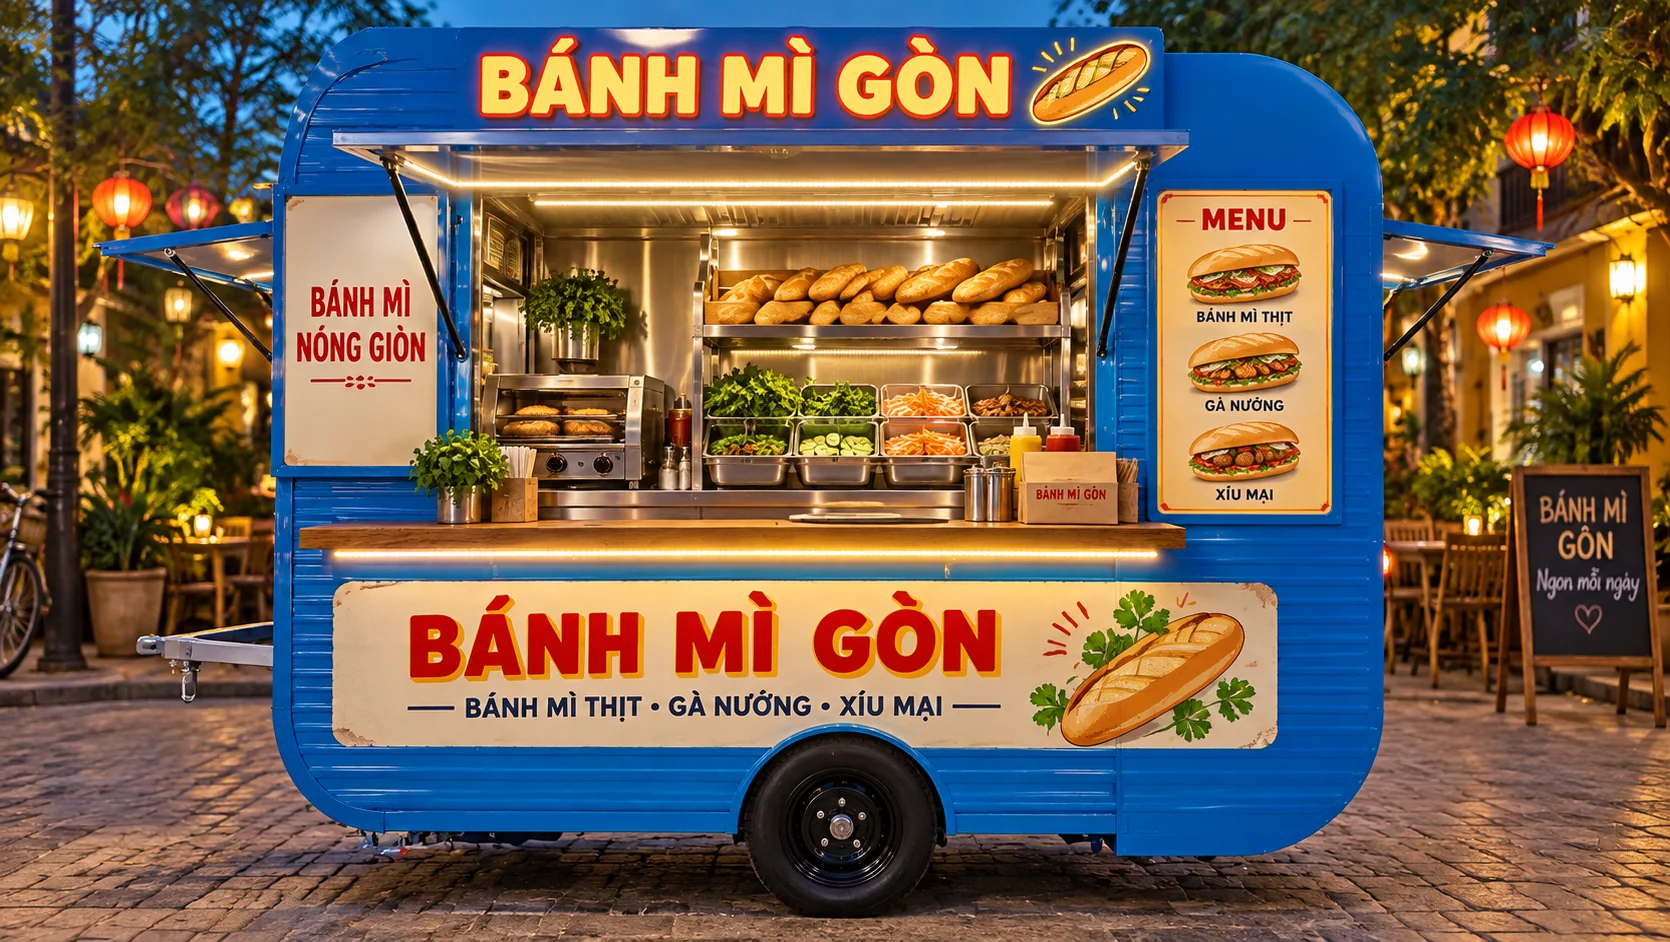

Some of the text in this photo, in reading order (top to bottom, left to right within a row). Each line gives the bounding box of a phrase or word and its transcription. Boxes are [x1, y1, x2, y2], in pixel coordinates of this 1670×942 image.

[480, 35, 1013, 119] BÁNH MÌ GÒN
[1202, 208, 1286, 231] MENU
[310, 278, 411, 318] BÁNH MÌ
[1196, 307, 1293, 327] BÁNH MÌ THỊT
[296, 324, 426, 362] NÓNG GIÒN
[1215, 485, 1274, 504] XÍU MẠI
[1539, 489, 1627, 524] BÁNH MÌ
[1558, 525, 1613, 560] GÔN
[1536, 567, 1573, 600] Ngon
[409, 590, 1002, 684] BÁNH MÌ GÒN
[465, 689, 943, 722] BÁNH MÌ THỊT GÀ NƯỚNG XÍU MẠI
